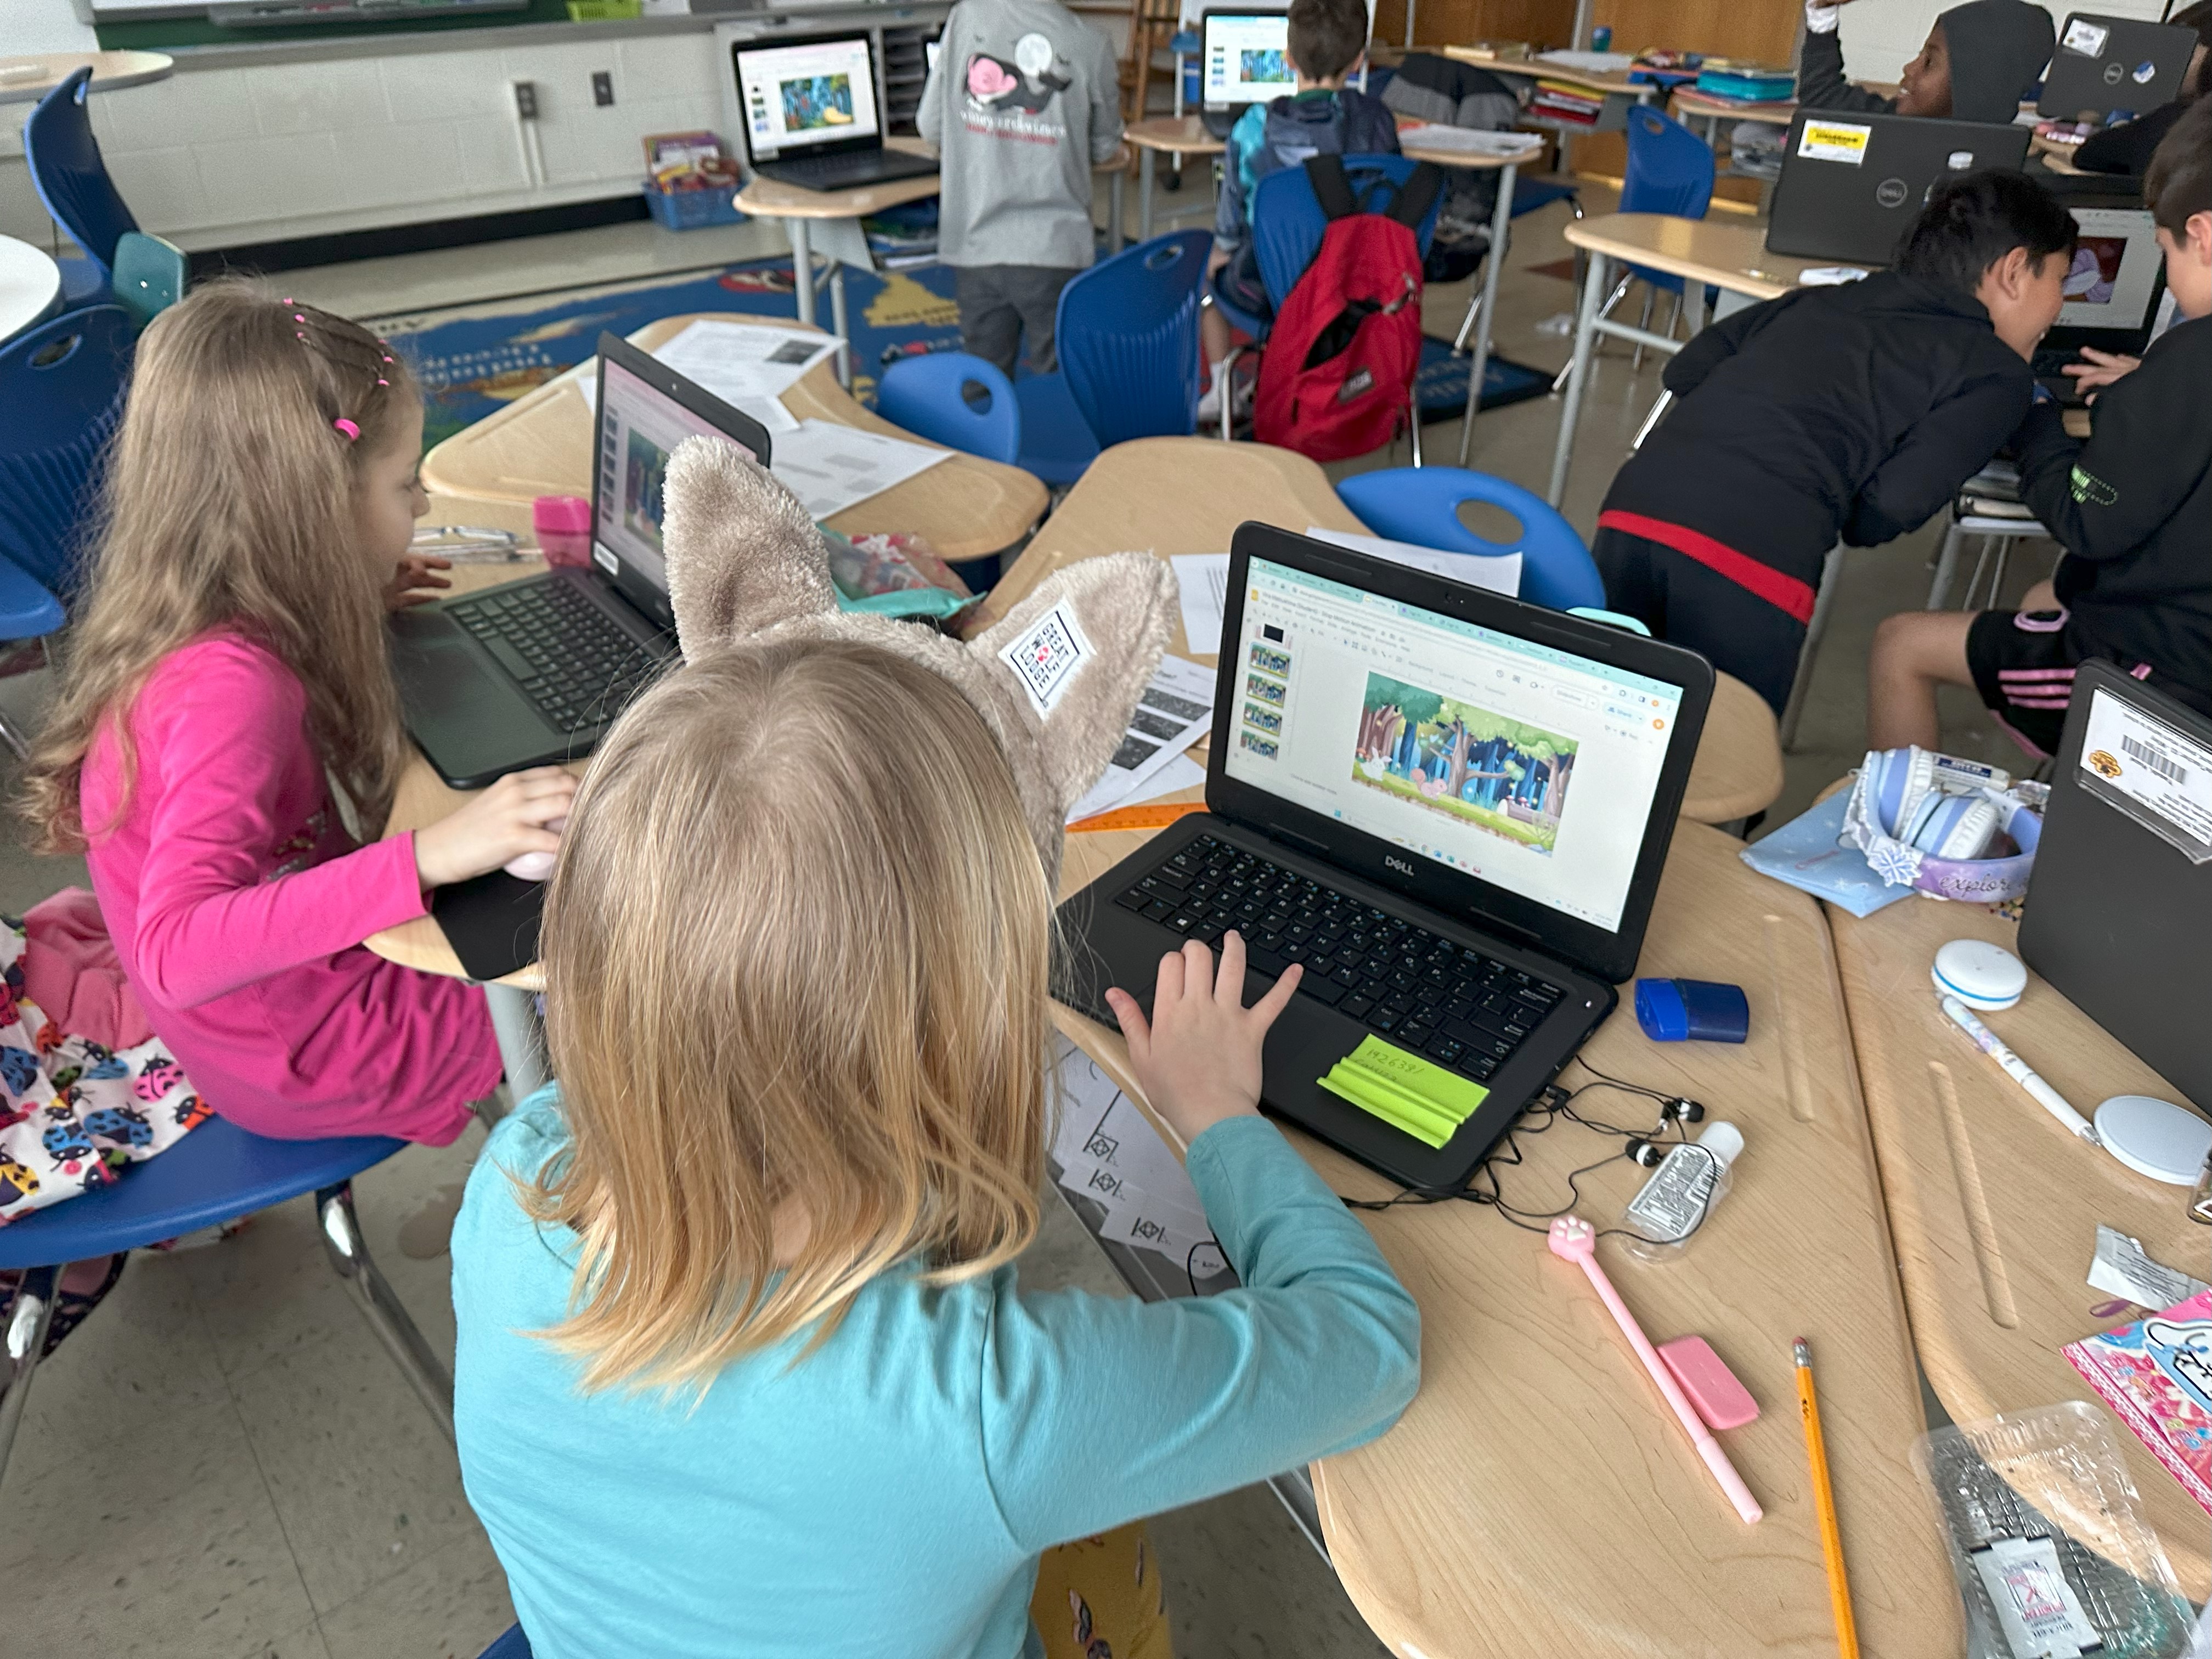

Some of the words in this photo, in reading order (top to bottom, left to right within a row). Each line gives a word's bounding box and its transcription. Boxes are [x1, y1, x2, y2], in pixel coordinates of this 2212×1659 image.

[1042, 622, 1070, 663] GREAT
[1020, 645, 1050, 690] LODGE
[1385, 855, 1414, 877] DELL
